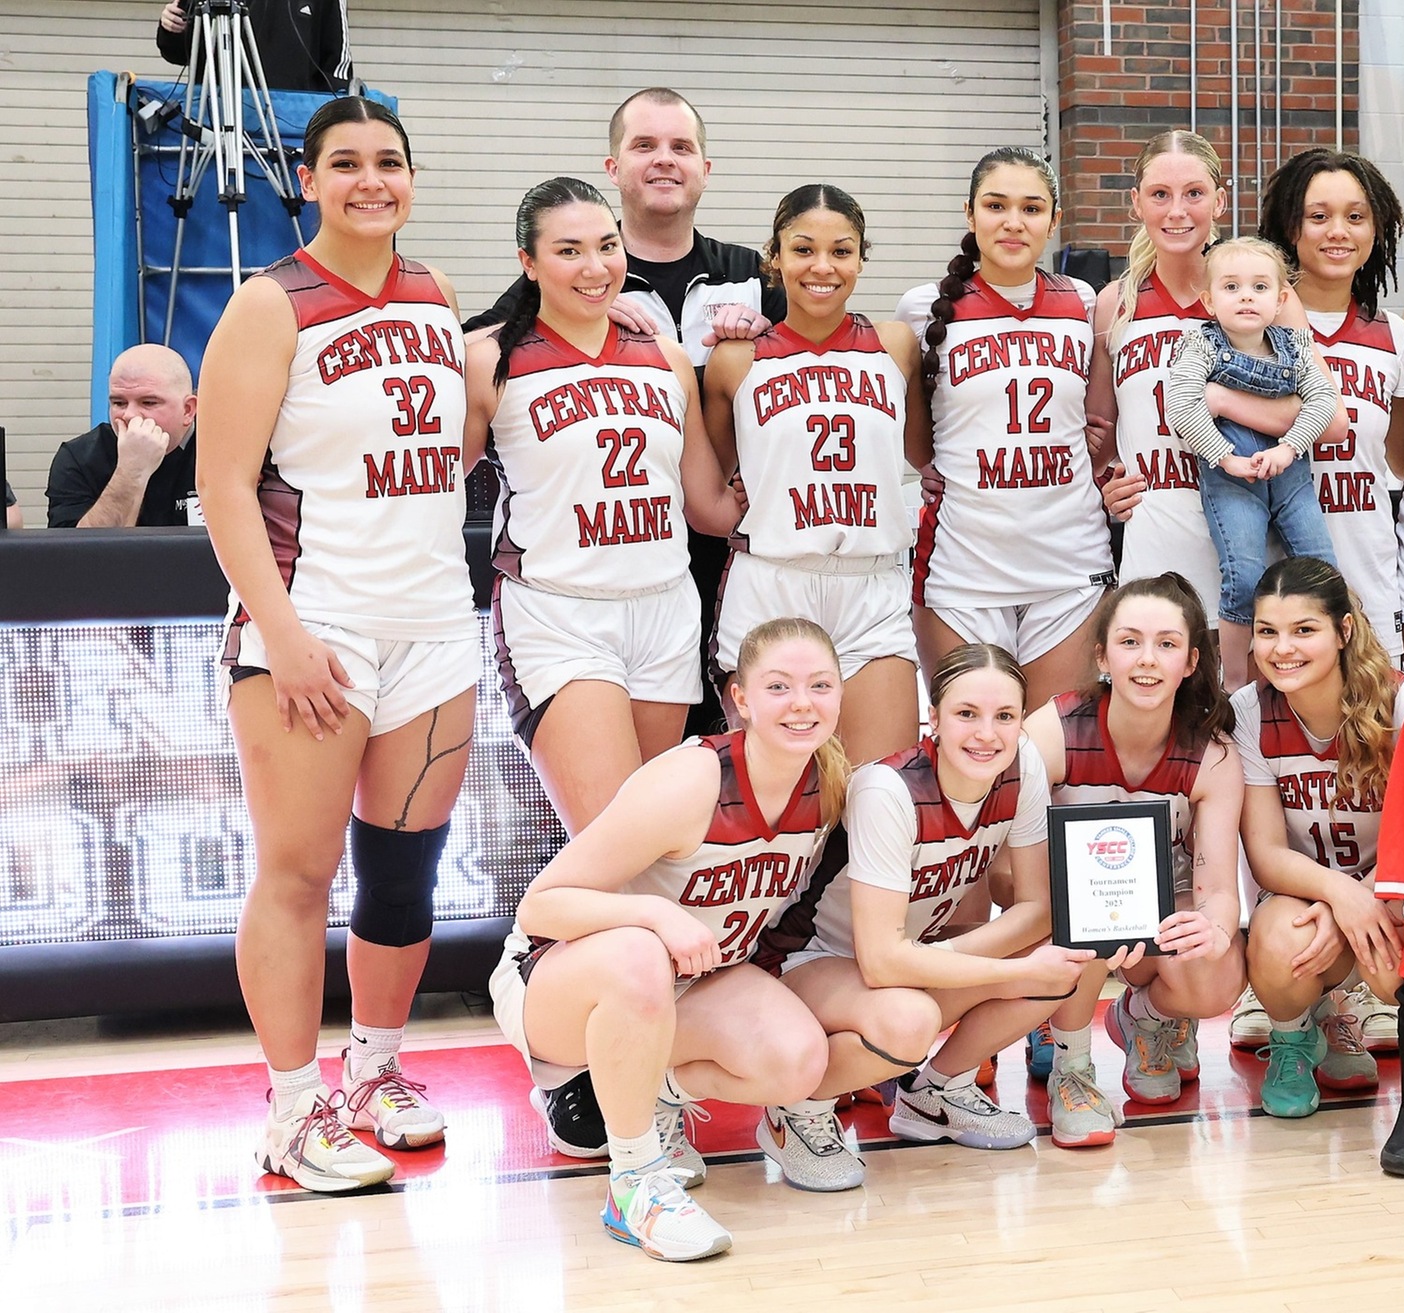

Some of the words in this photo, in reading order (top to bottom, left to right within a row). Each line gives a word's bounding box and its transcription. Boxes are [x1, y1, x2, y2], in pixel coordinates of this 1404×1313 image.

[317, 319, 464, 386] CENTRAL
[949, 331, 1090, 387] CENTRAL
[1116, 330, 1182, 388] CENT
[383, 376, 442, 437] 32
[529, 377, 682, 442] CENTRAL
[754, 366, 896, 426] CENTRAL
[1005, 378, 1055, 434] 12
[597, 428, 649, 488] 22
[806, 414, 856, 472] 23
[977, 445, 1073, 489] MAINE
[364, 446, 460, 499] MAINE
[1317, 472, 1376, 513] AINE
[574, 496, 673, 548] MAINE
[789, 484, 877, 530] MAINE
[1087, 841, 1128, 855] YSCC
[1309, 821, 1360, 867] 15
[679, 852, 808, 907] CENTRA
[1089, 877, 1137, 886] Tournament
[1092, 888, 1134, 897] Champion
[1104, 899, 1123, 908] 2023
[1113, 924, 1147, 932] Basketball
